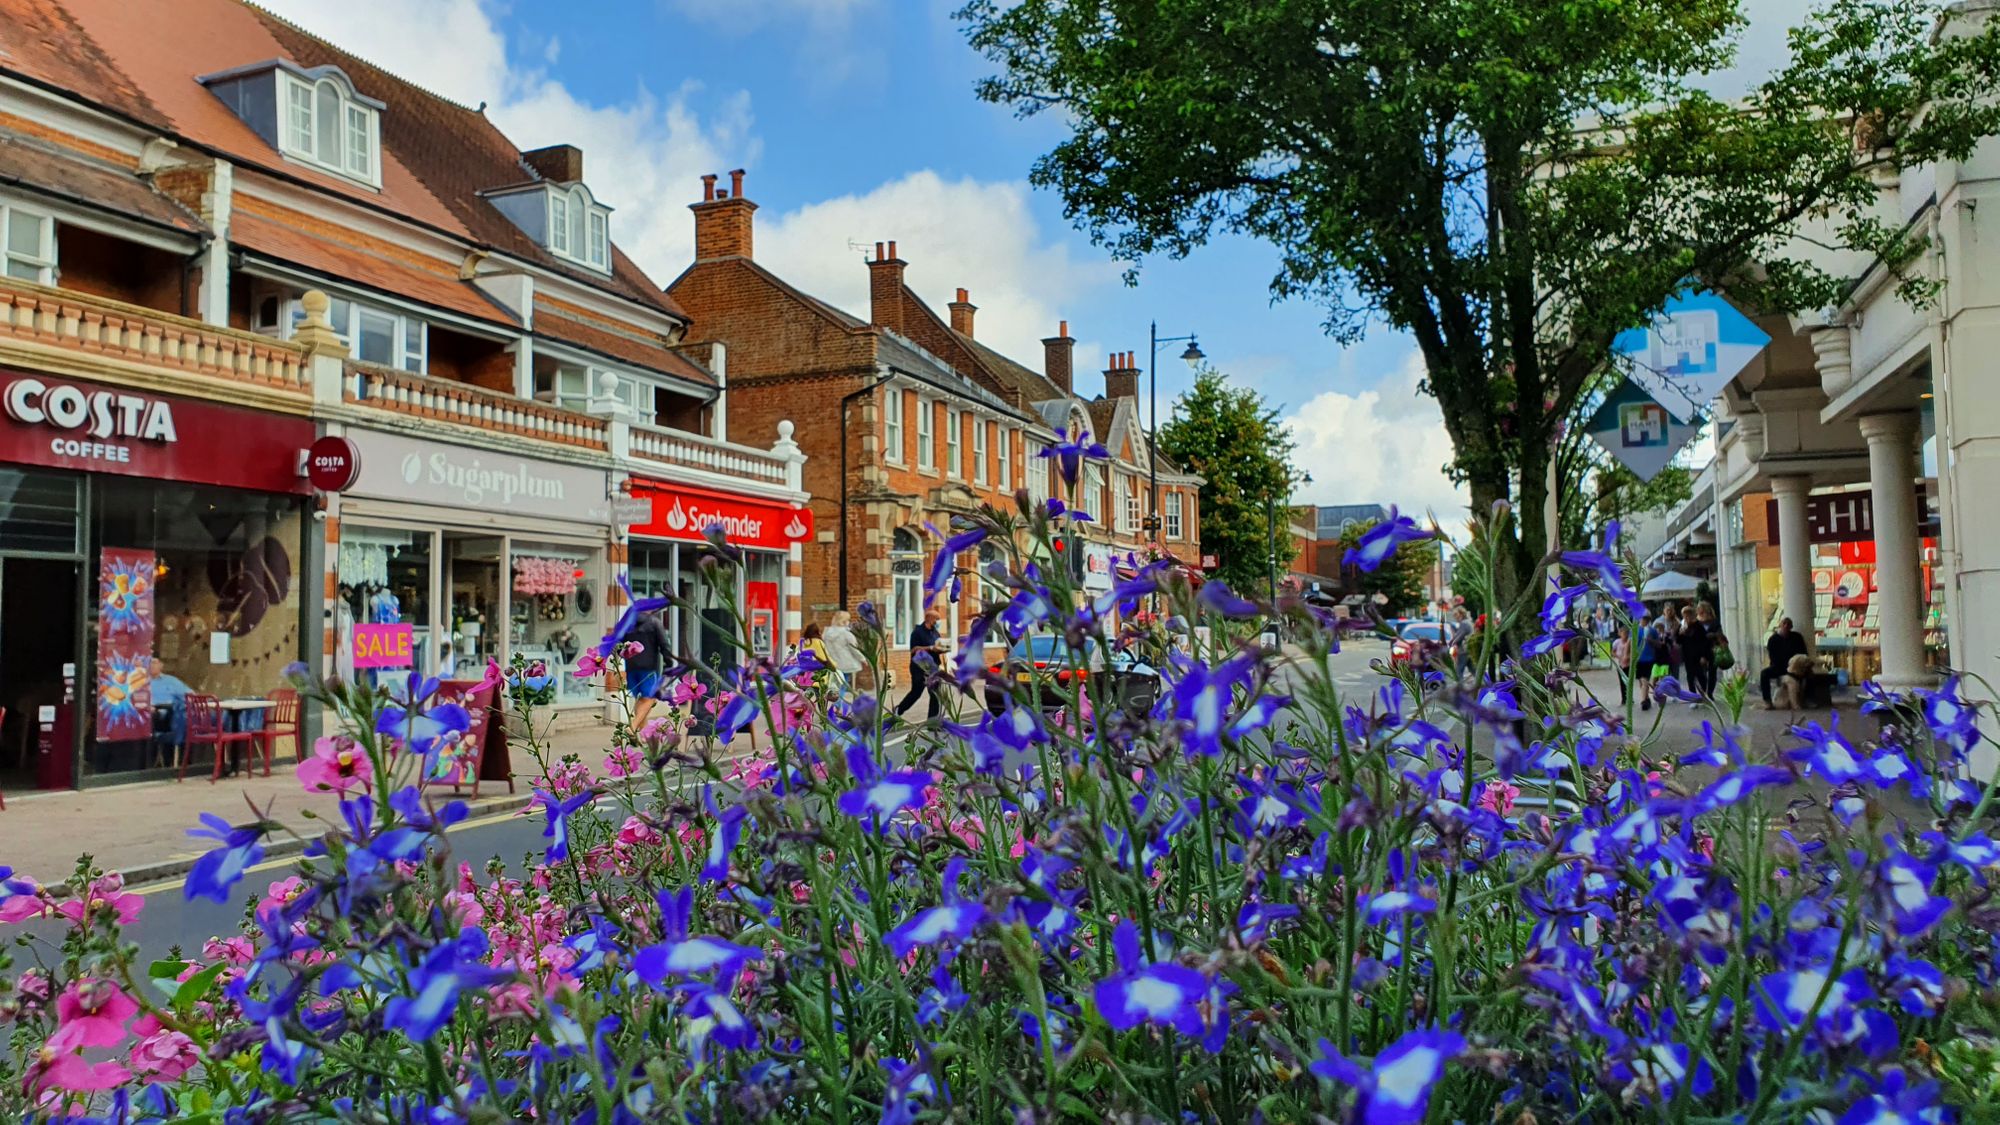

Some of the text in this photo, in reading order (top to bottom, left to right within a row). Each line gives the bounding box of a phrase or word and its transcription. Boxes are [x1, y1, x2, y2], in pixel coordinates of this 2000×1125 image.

[5, 378, 178, 442] COSTA
[1630, 420, 1658, 429] HART
[51, 438, 130, 462] COFFEE
[315, 456, 344, 468] COSTA
[428, 452, 565, 505] Sugarplum
[1807, 498, 1871, 535] .HI
[356, 632, 409, 658] SALE
